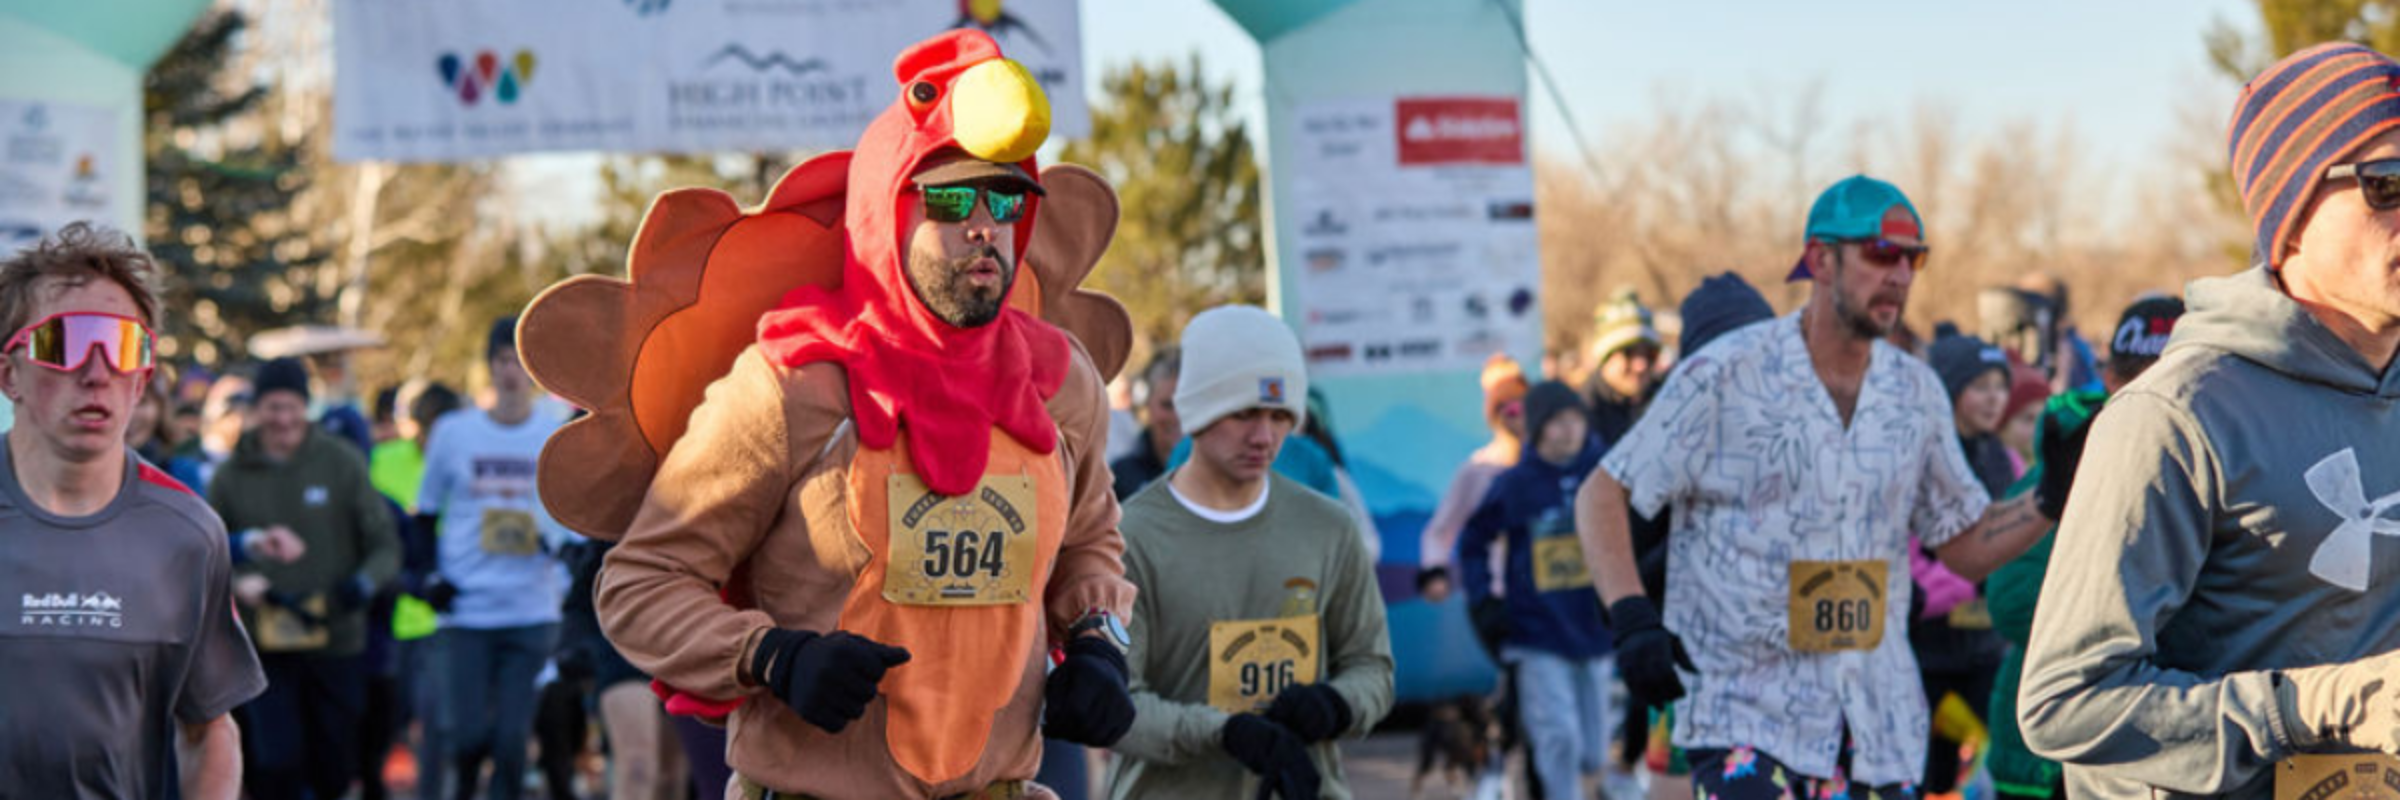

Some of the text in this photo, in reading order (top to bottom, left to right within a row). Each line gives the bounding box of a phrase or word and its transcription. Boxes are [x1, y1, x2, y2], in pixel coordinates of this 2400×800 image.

[669, 77, 866, 103] HIGH POINT
[924, 530, 1004, 578] 564
[21, 615, 122, 628] RACING
[1815, 598, 1870, 633] 860
[1240, 659, 1295, 697] 916
